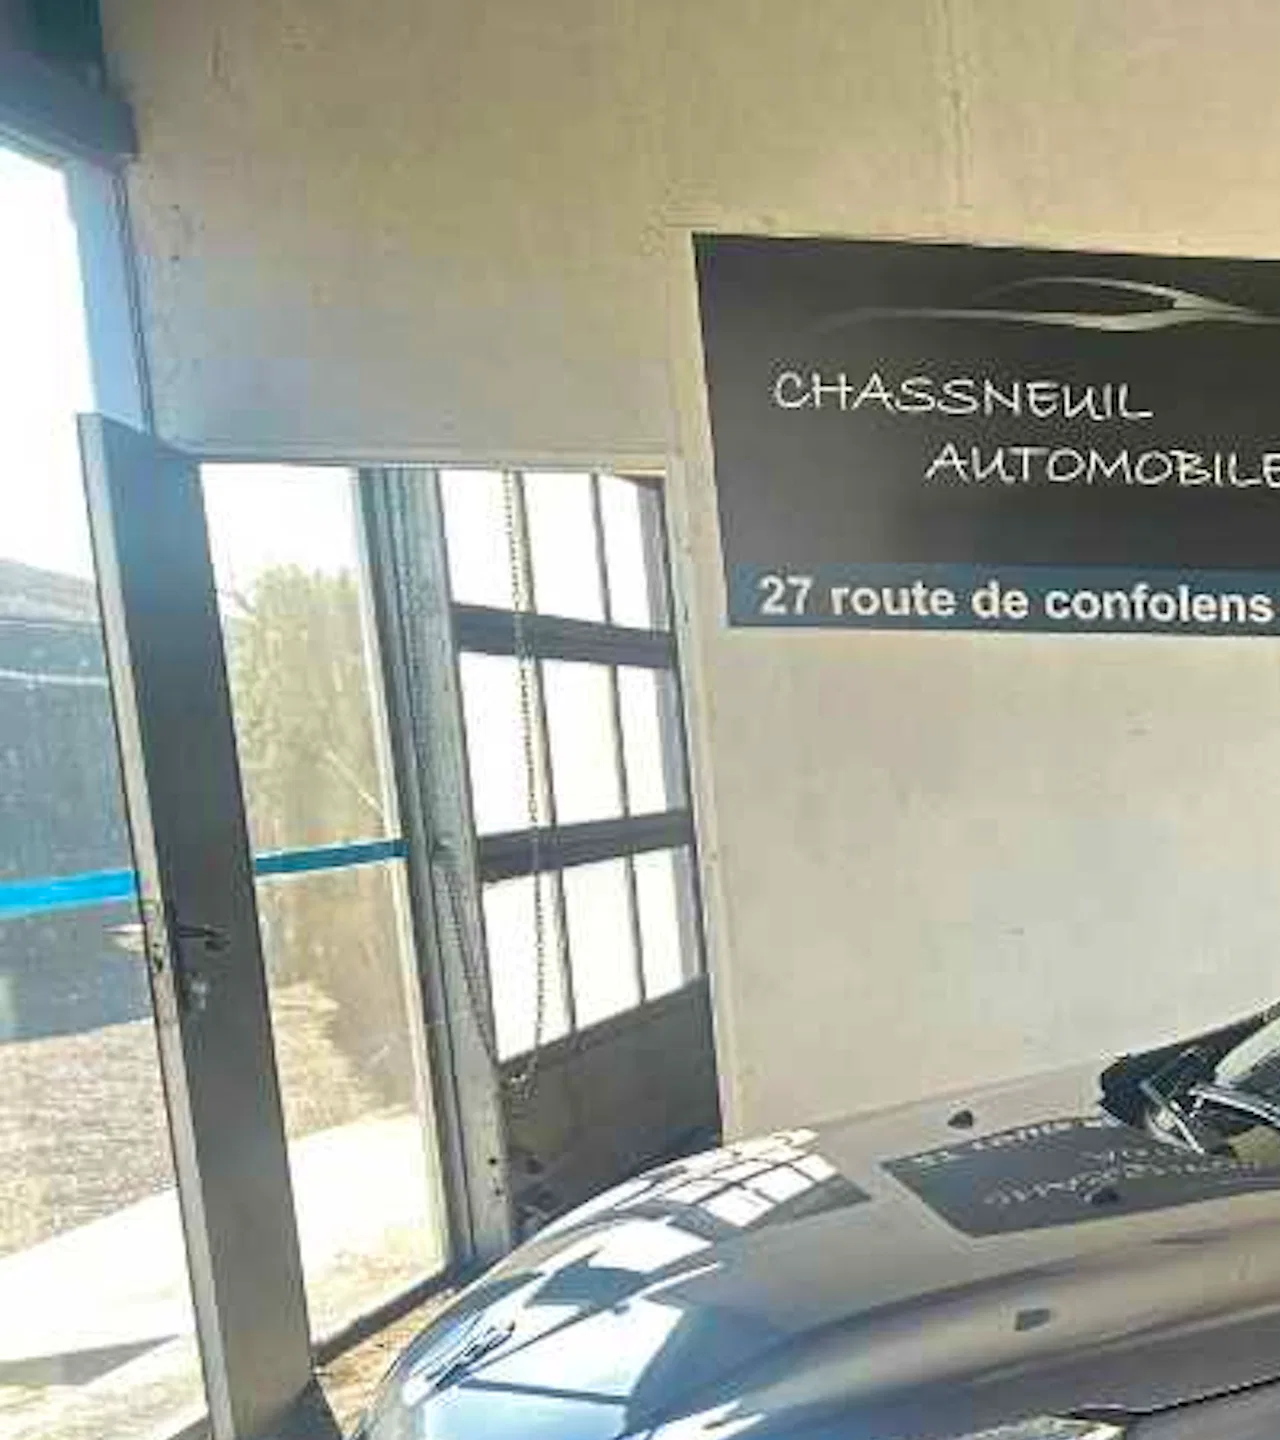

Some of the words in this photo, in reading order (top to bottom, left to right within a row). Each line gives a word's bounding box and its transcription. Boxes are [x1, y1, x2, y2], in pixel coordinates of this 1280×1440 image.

[773, 371, 1154, 420] CHASSNEUIL
[759, 577, 812, 614] 27
[830, 578, 955, 617] route
[970, 580, 1029, 618] de
[1045, 584, 1273, 623] confolens
